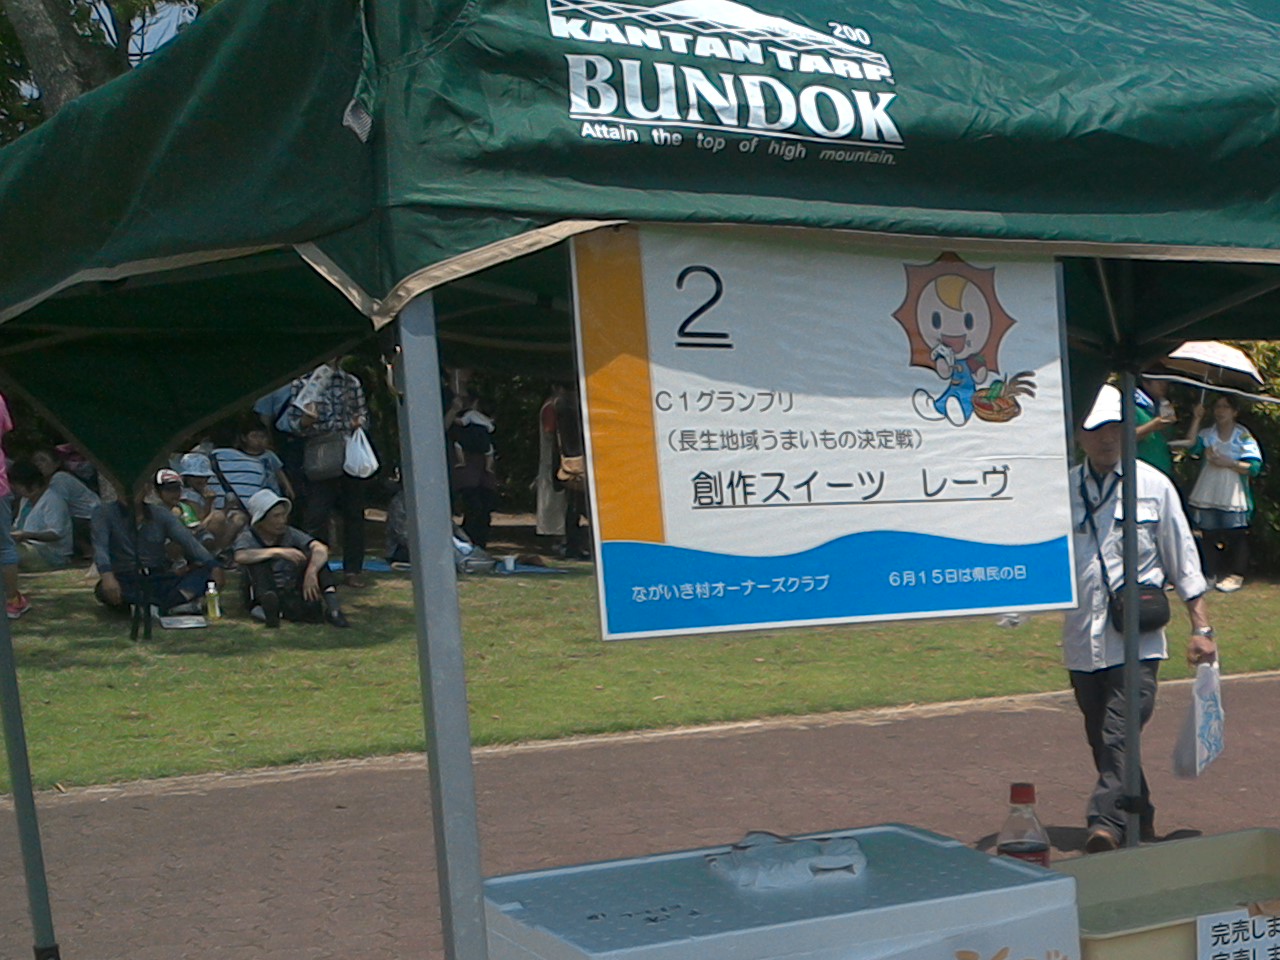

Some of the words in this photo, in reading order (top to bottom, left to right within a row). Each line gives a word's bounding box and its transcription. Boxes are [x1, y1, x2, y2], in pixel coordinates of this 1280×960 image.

[551, 15, 765, 65] KANTAN
[828, 21, 872, 46] 200
[565, 53, 904, 143] BUNDOK
[580, 121, 640, 144] Attain
[651, 128, 683, 146] the
[696, 132, 726, 153] top
[738, 137, 760, 153] of
[768, 139, 807, 161] high
[818, 148, 898, 166] mountain.
[675, 264, 731, 339] 2
[691, 469, 885, 506] 創作スイーツ
[921, 465, 1013, 498] レーヴ
